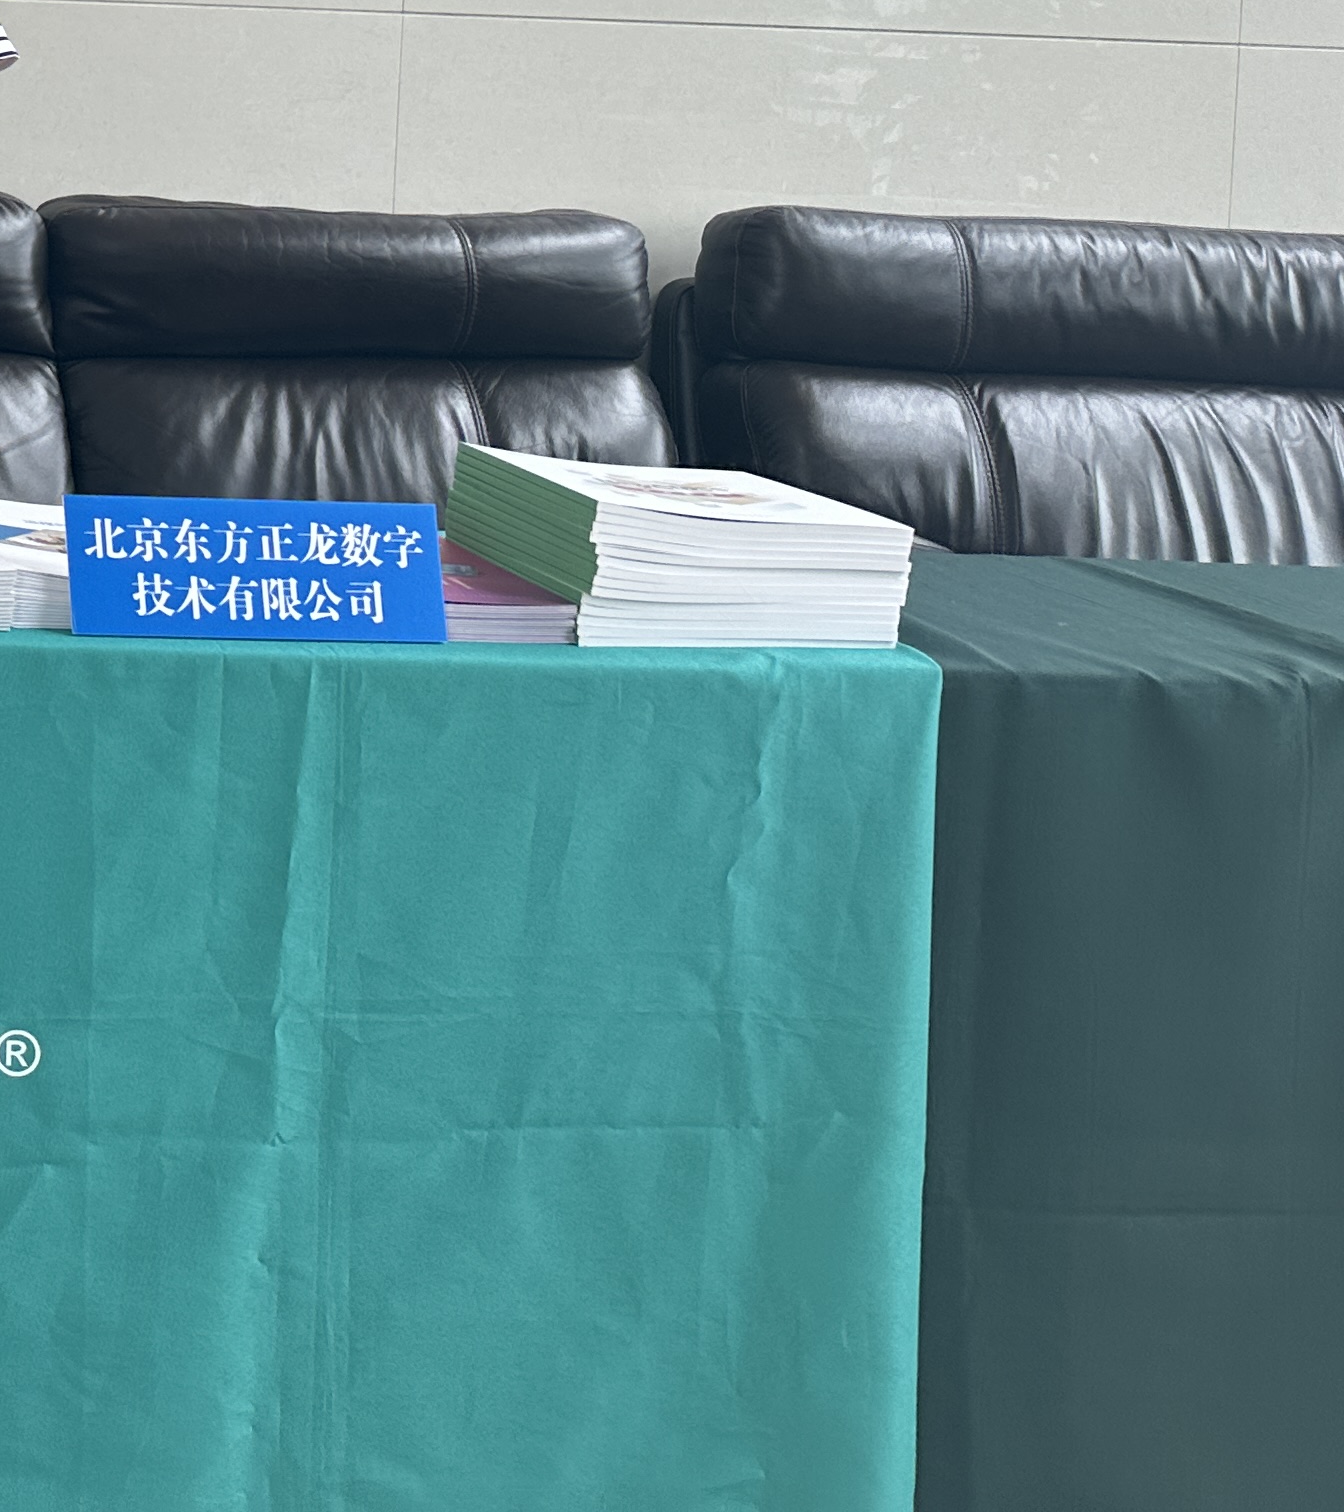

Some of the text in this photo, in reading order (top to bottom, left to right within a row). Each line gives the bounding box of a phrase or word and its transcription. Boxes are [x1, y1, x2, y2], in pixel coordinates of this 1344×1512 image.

[83, 517, 424, 569] 北京东方正龙数字
[132, 572, 385, 624] 技术有限公司
